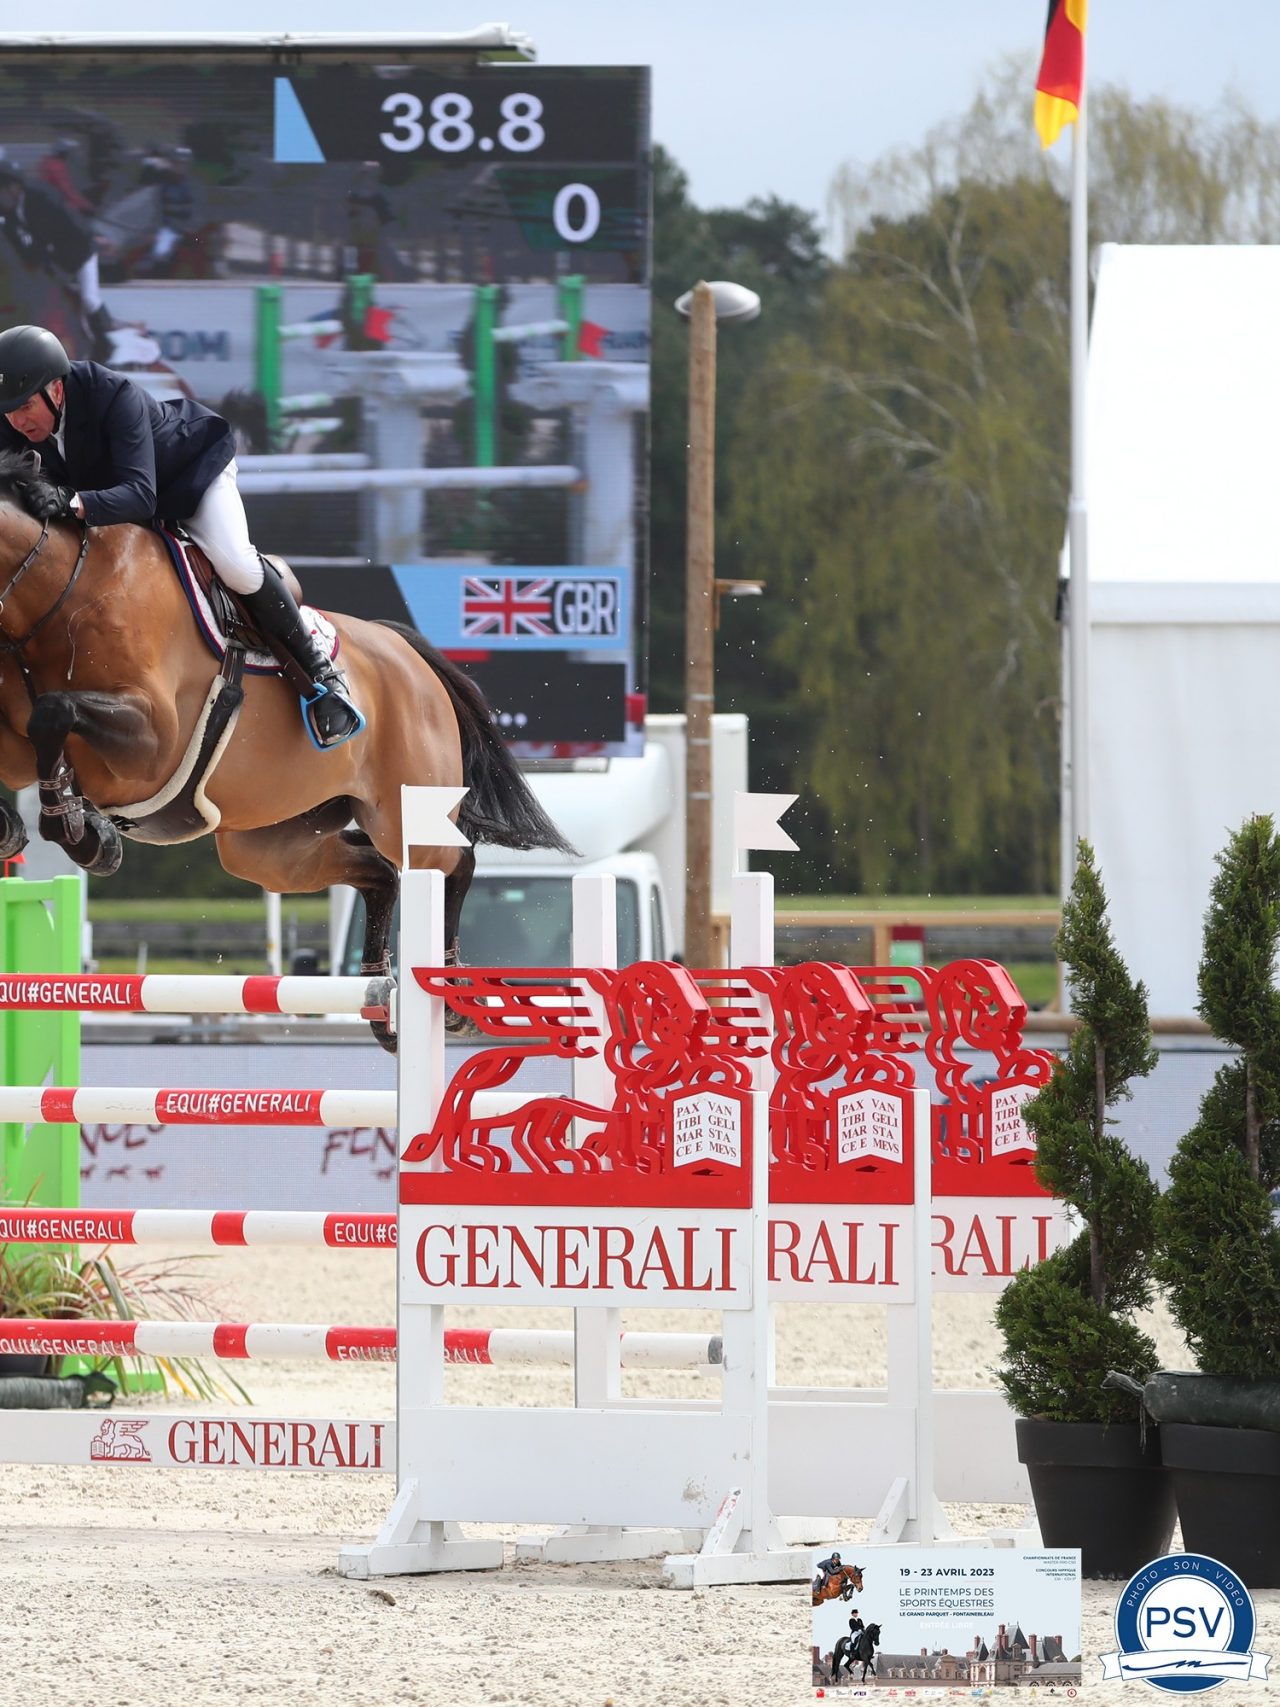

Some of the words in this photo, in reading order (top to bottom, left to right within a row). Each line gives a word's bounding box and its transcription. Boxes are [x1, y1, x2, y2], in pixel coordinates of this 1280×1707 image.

[379, 92, 545, 153] 38.8
[553, 182, 601, 242] 0
[554, 582, 616, 634] GBR
[166, 1092, 312, 1114] EQUI#GENERALI
[708, 1101, 732, 1116] VAN
[842, 1099, 864, 1115] PAX
[872, 1098, 895, 1113] VAN
[995, 1094, 1017, 1108] PAX
[677, 1102, 699, 1118] PAX
[995, 1106, 1019, 1120] TIBI
[677, 1115, 701, 1130] TIBI
[708, 1115, 735, 1131] GELI
[842, 1112, 865, 1127] TIBI
[872, 1112, 898, 1127] GELI
[995, 1119, 1020, 1134] MAR
[676, 1128, 703, 1144] MAR
[709, 1128, 731, 1143] STA
[842, 1125, 867, 1141] MAR
[873, 1125, 894, 1139] STA
[995, 1134, 1010, 1147] CE
[1013, 1131, 1020, 1142] E
[676, 1145, 692, 1157] CE
[696, 1141, 703, 1153] E
[709, 1141, 737, 1158] MEVS
[841, 1141, 856, 1153] CE
[860, 1138, 867, 1149] E
[873, 1138, 900, 1154] MEVS
[334, 1222, 397, 1243] EQUI#G
[767, 1219, 901, 1287] RALI
[930, 1213, 1053, 1277] RALI
[415, 1223, 738, 1292] GENERALI
[168, 1419, 385, 1469] GENERALI
